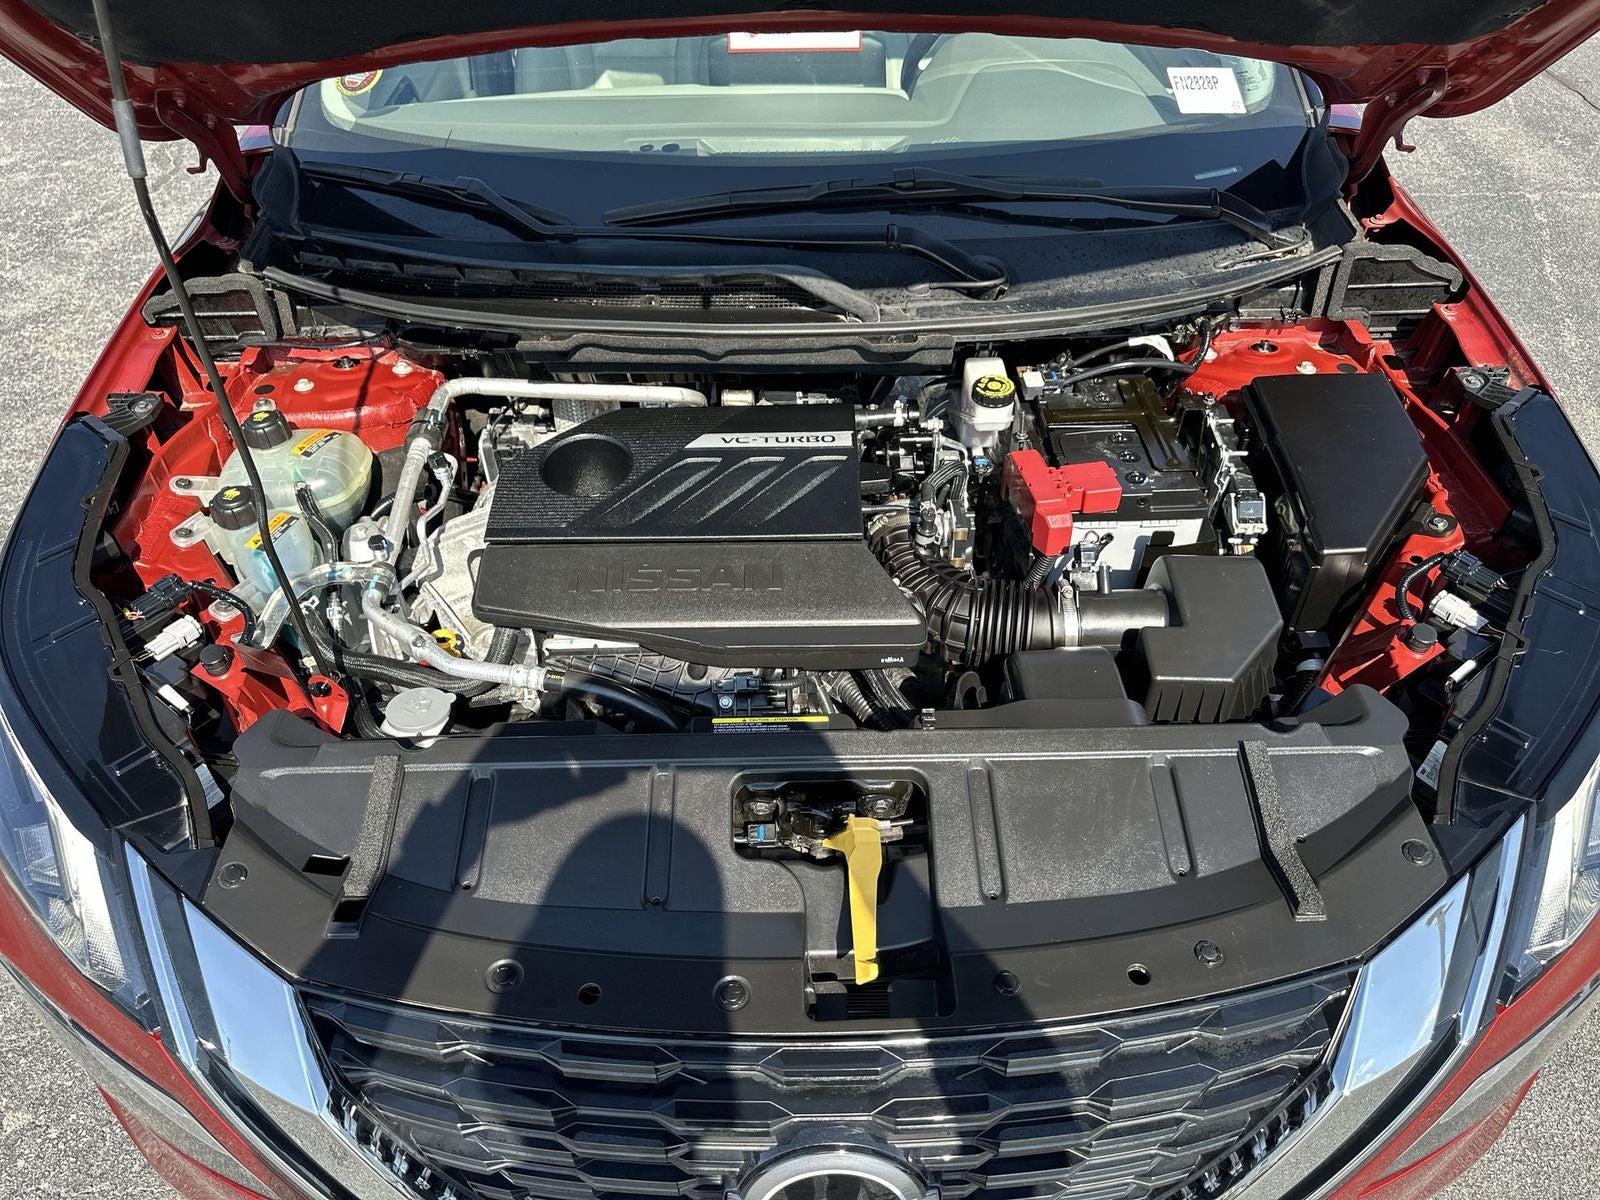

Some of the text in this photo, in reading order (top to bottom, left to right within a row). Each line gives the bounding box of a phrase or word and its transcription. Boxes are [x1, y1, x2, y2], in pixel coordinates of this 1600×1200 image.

[1173, 75, 1219, 90] FN2828P
[720, 434, 836, 444] VC-TURBO
[568, 564, 783, 592] NISSAN
